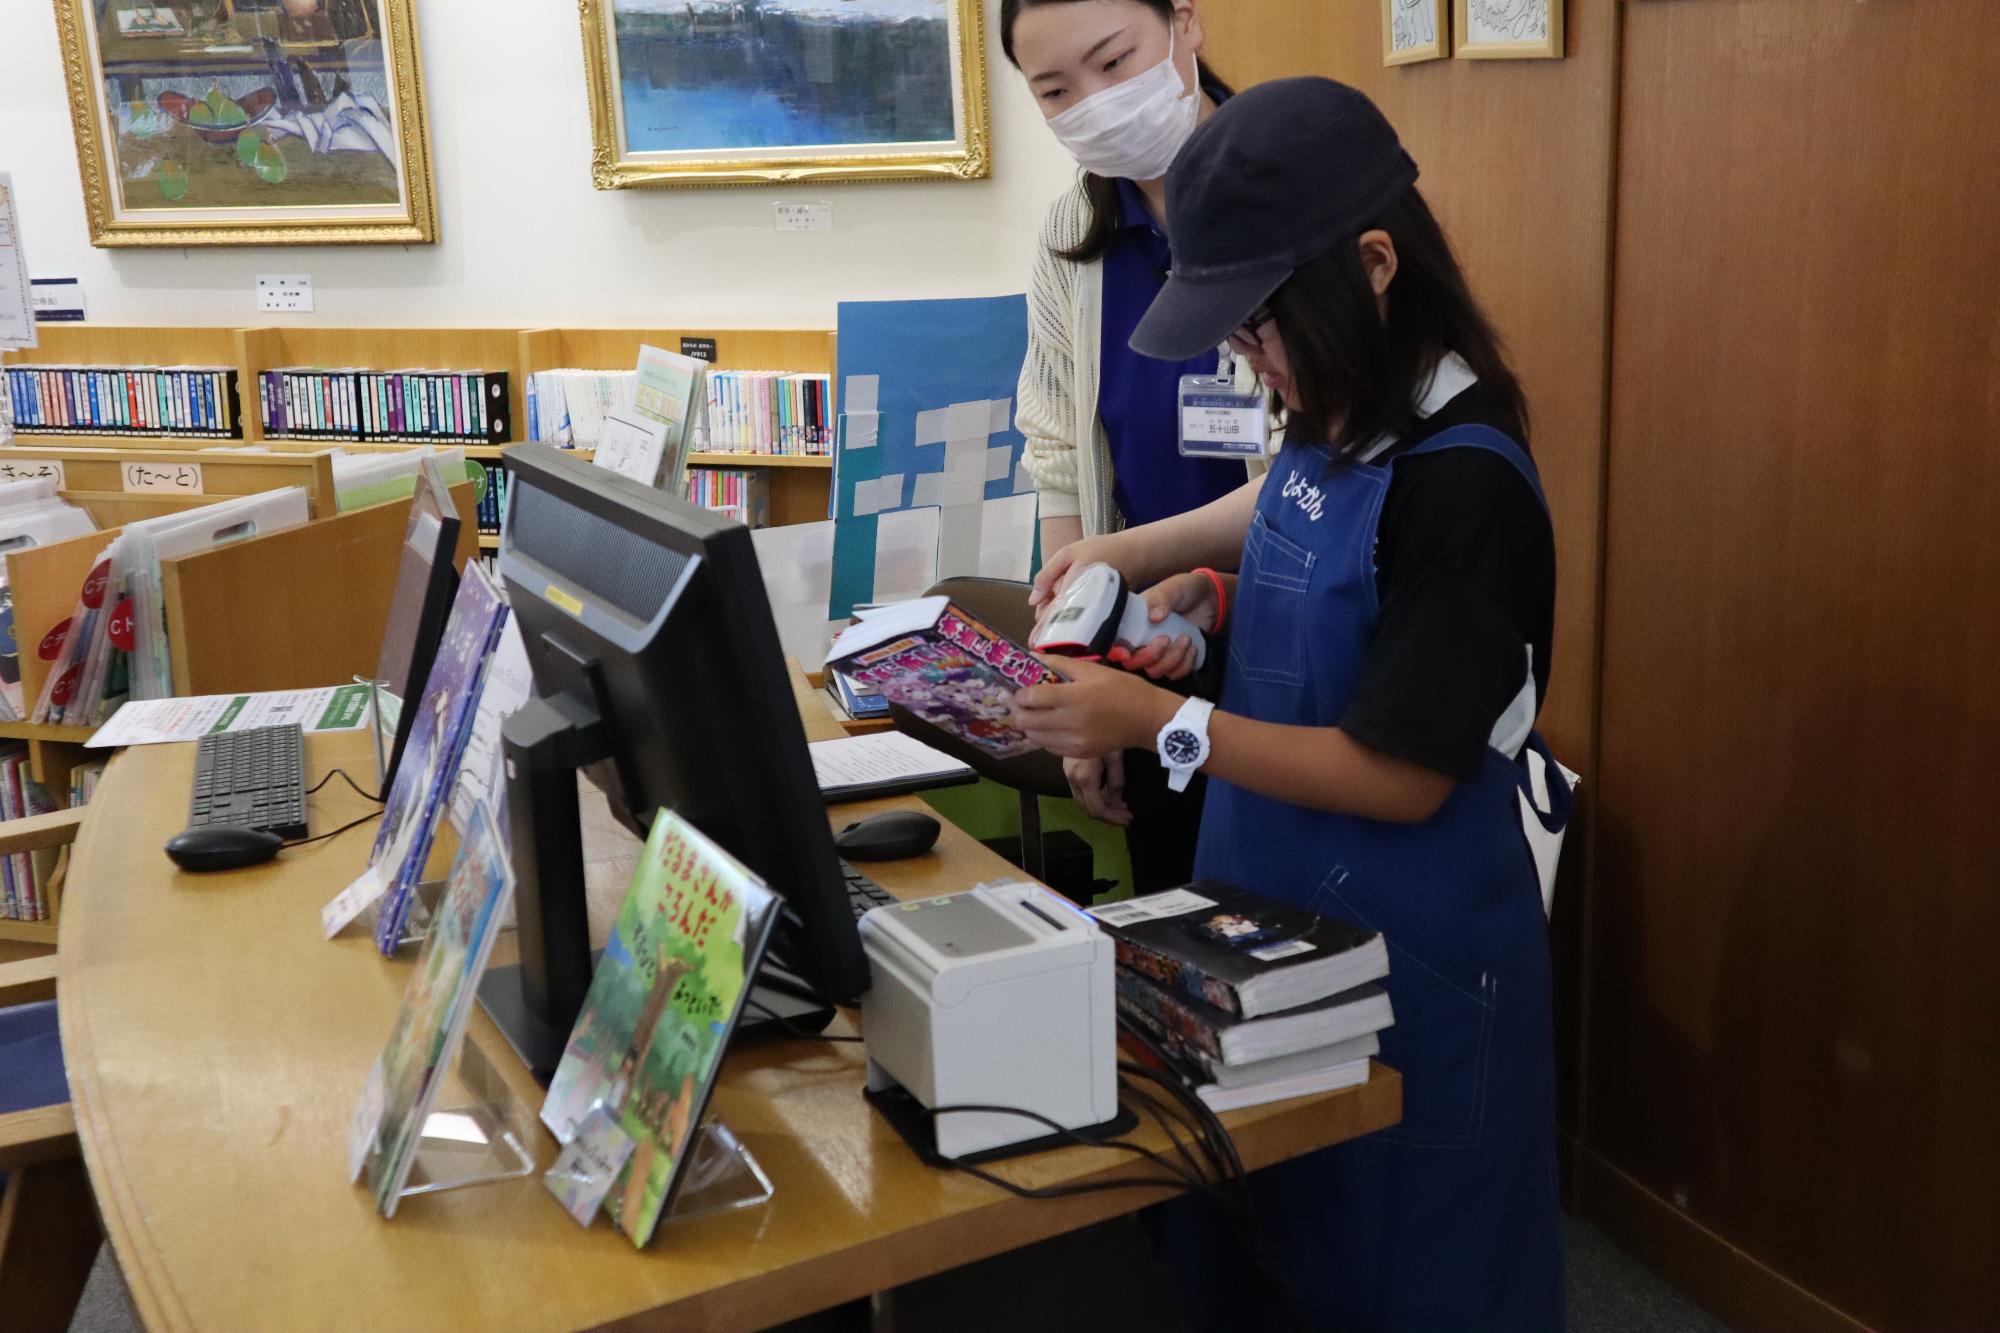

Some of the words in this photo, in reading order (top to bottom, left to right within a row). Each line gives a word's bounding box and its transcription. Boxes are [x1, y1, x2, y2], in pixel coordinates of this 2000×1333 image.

[1208, 424, 1239, 434] 五十山田
[657, 882, 717, 948] ころんだ
